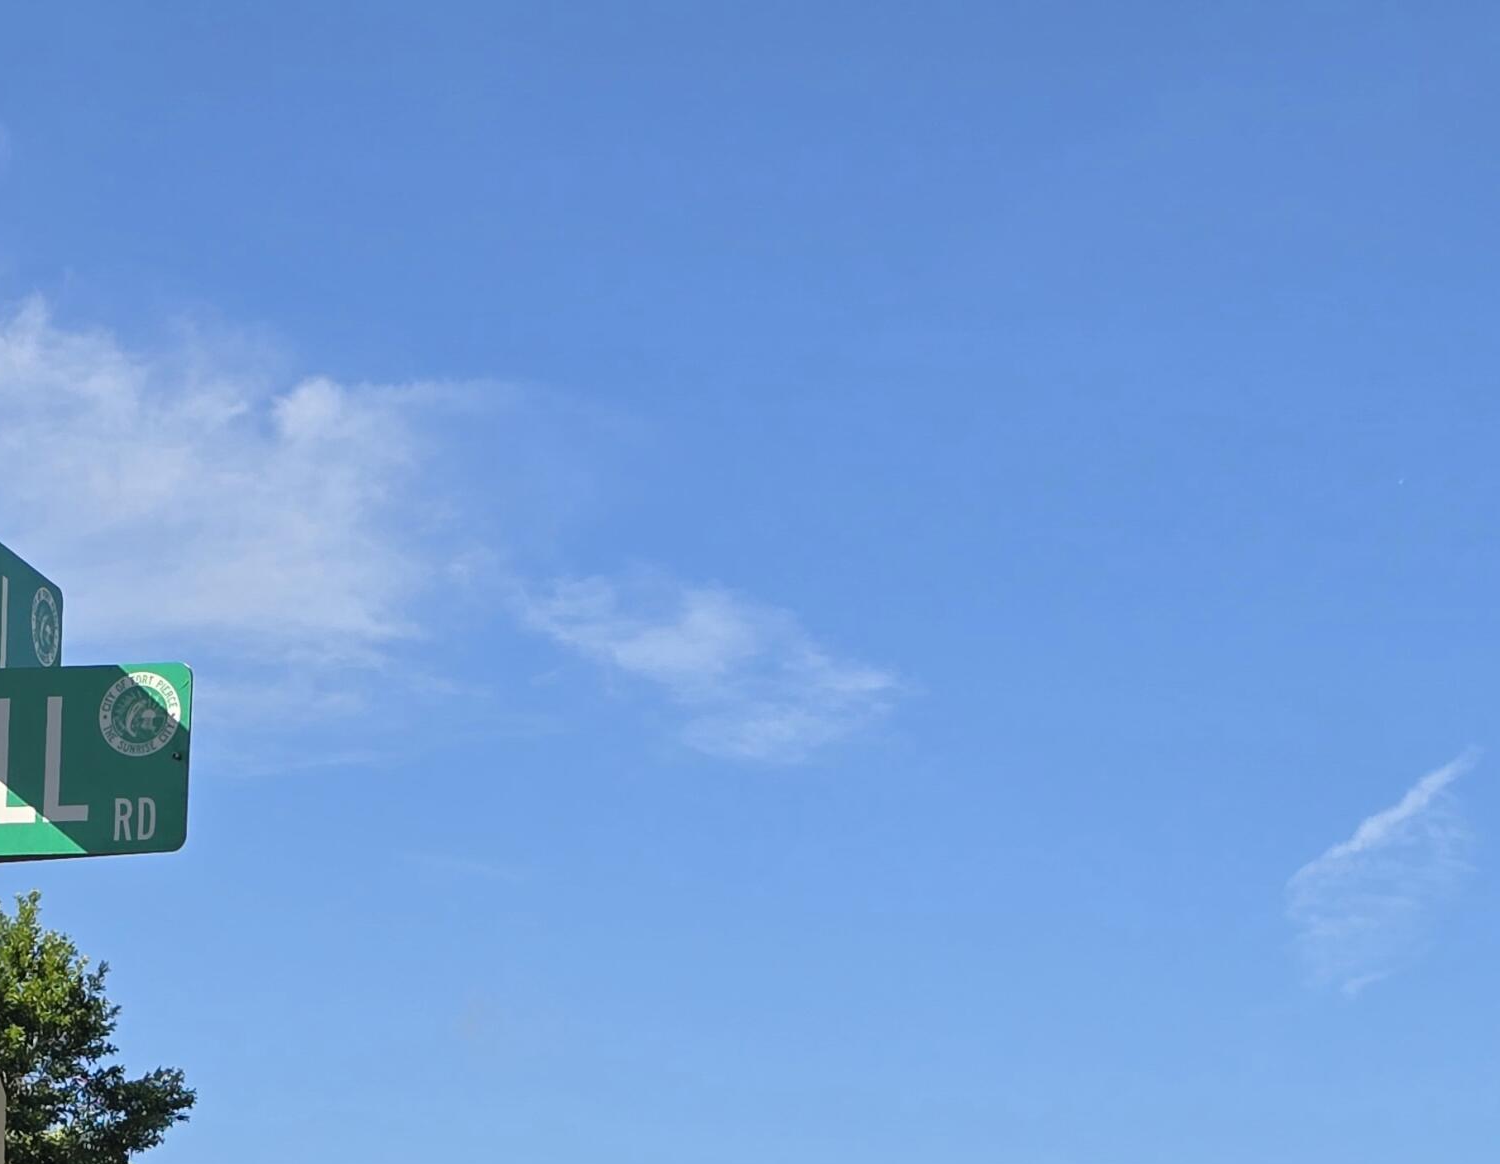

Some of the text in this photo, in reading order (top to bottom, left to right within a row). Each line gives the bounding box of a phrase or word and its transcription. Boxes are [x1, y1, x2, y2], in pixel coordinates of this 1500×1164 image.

[102, 692, 116, 711] CITY
[115, 679, 127, 692] OF
[156, 679, 178, 708] PIERCE
[103, 723, 176, 753] THE SUNRISE CITY
[113, 798, 156, 842] RD
